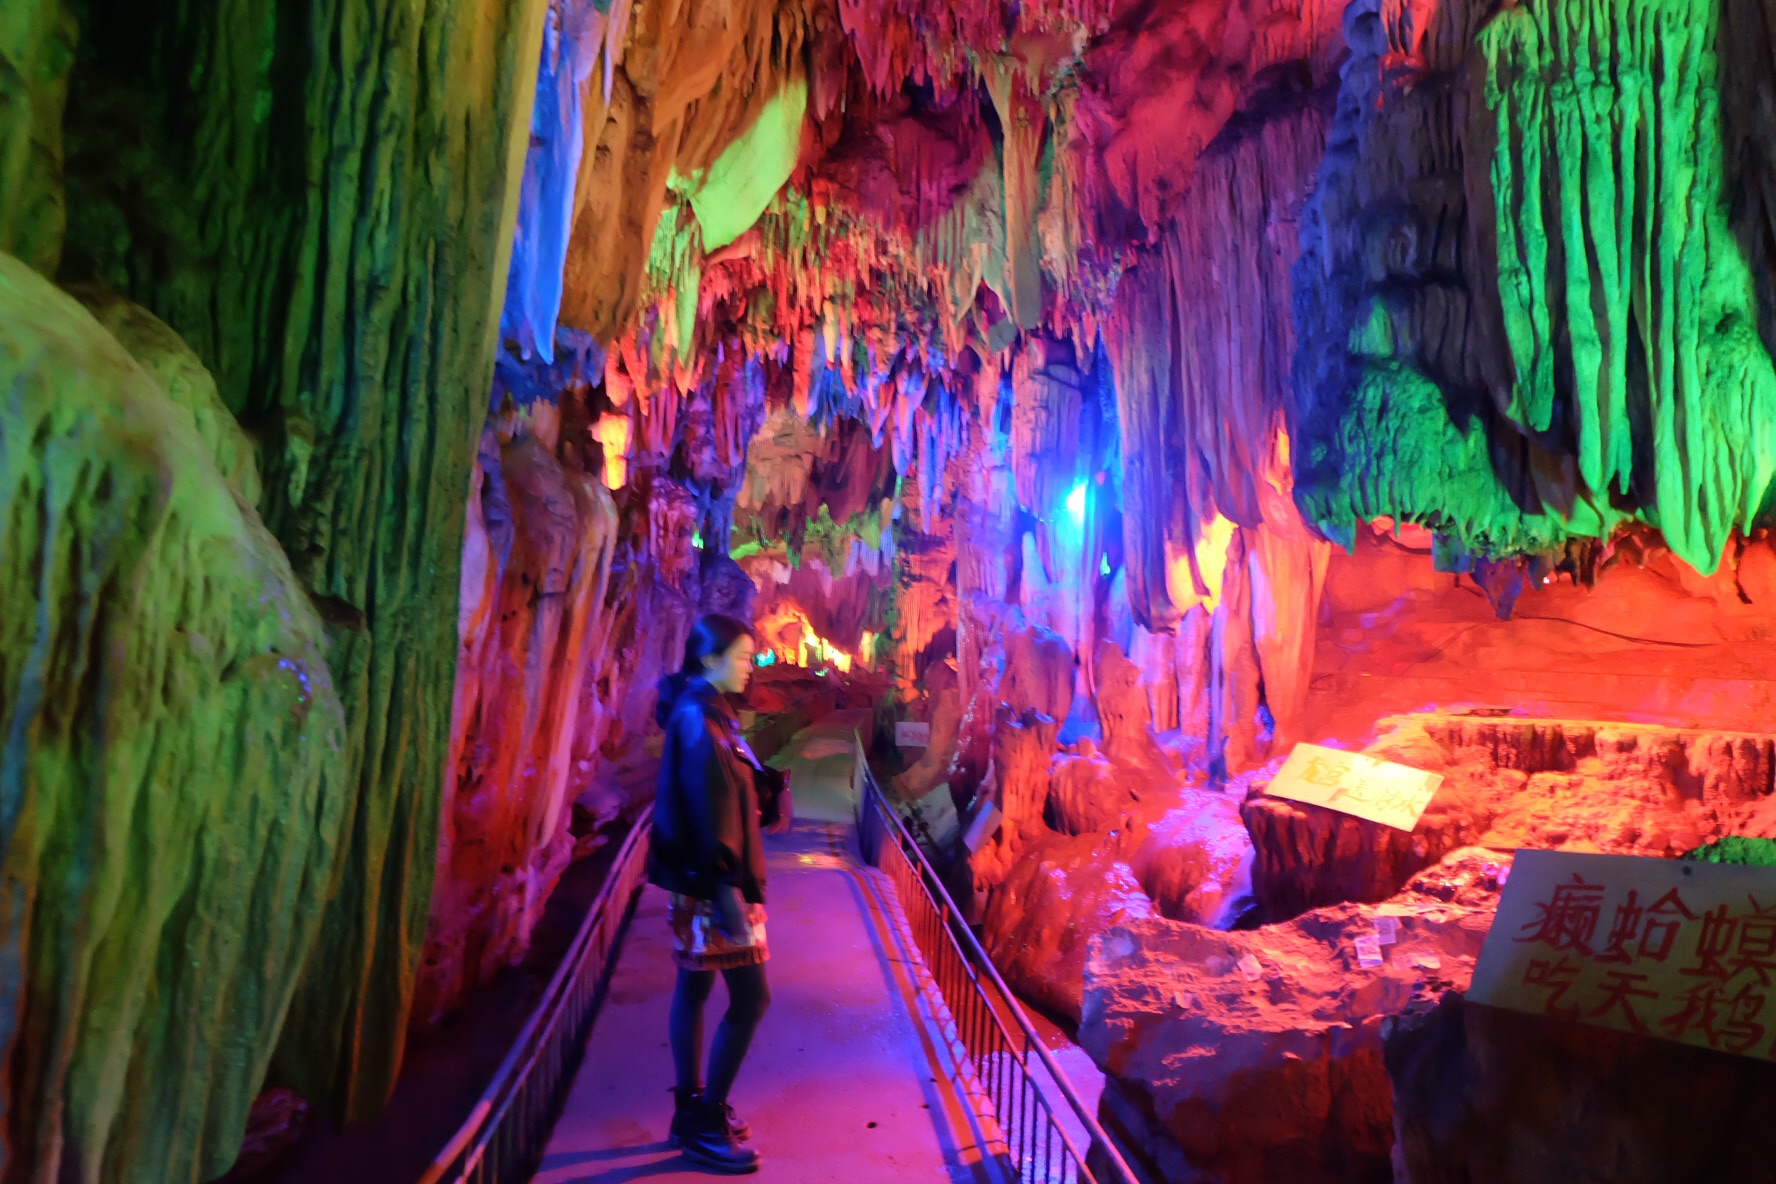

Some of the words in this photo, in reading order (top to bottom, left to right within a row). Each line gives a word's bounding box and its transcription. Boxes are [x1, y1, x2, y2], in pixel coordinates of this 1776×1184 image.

[1512, 872, 1776, 987] 癞蛤蟆
[1522, 955, 1776, 1057] 吃天鹅
